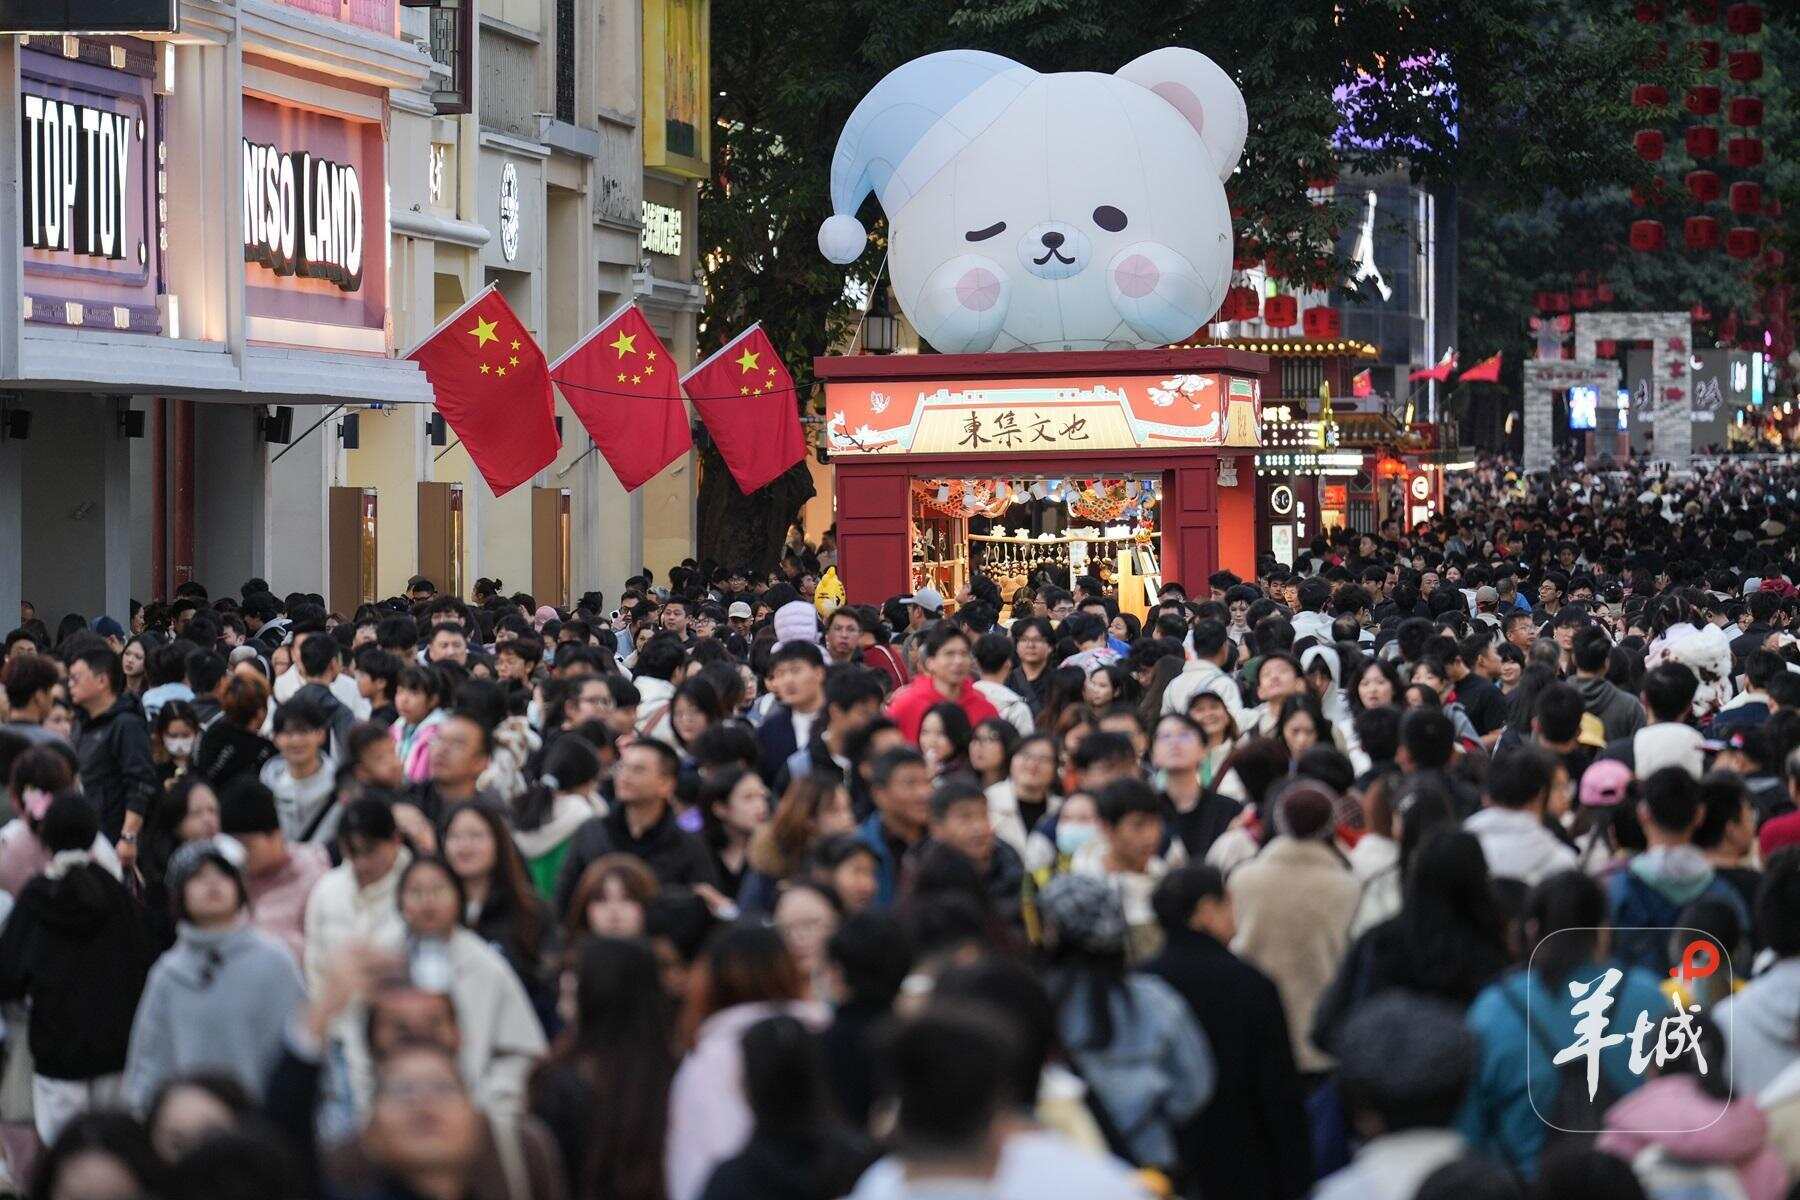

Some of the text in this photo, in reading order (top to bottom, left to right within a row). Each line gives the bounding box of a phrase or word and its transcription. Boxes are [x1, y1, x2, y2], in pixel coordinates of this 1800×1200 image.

[25, 94, 130, 260] TOP TOY
[302, 152, 363, 277] LAND
[957, 410, 1090, 449] 東集文也
